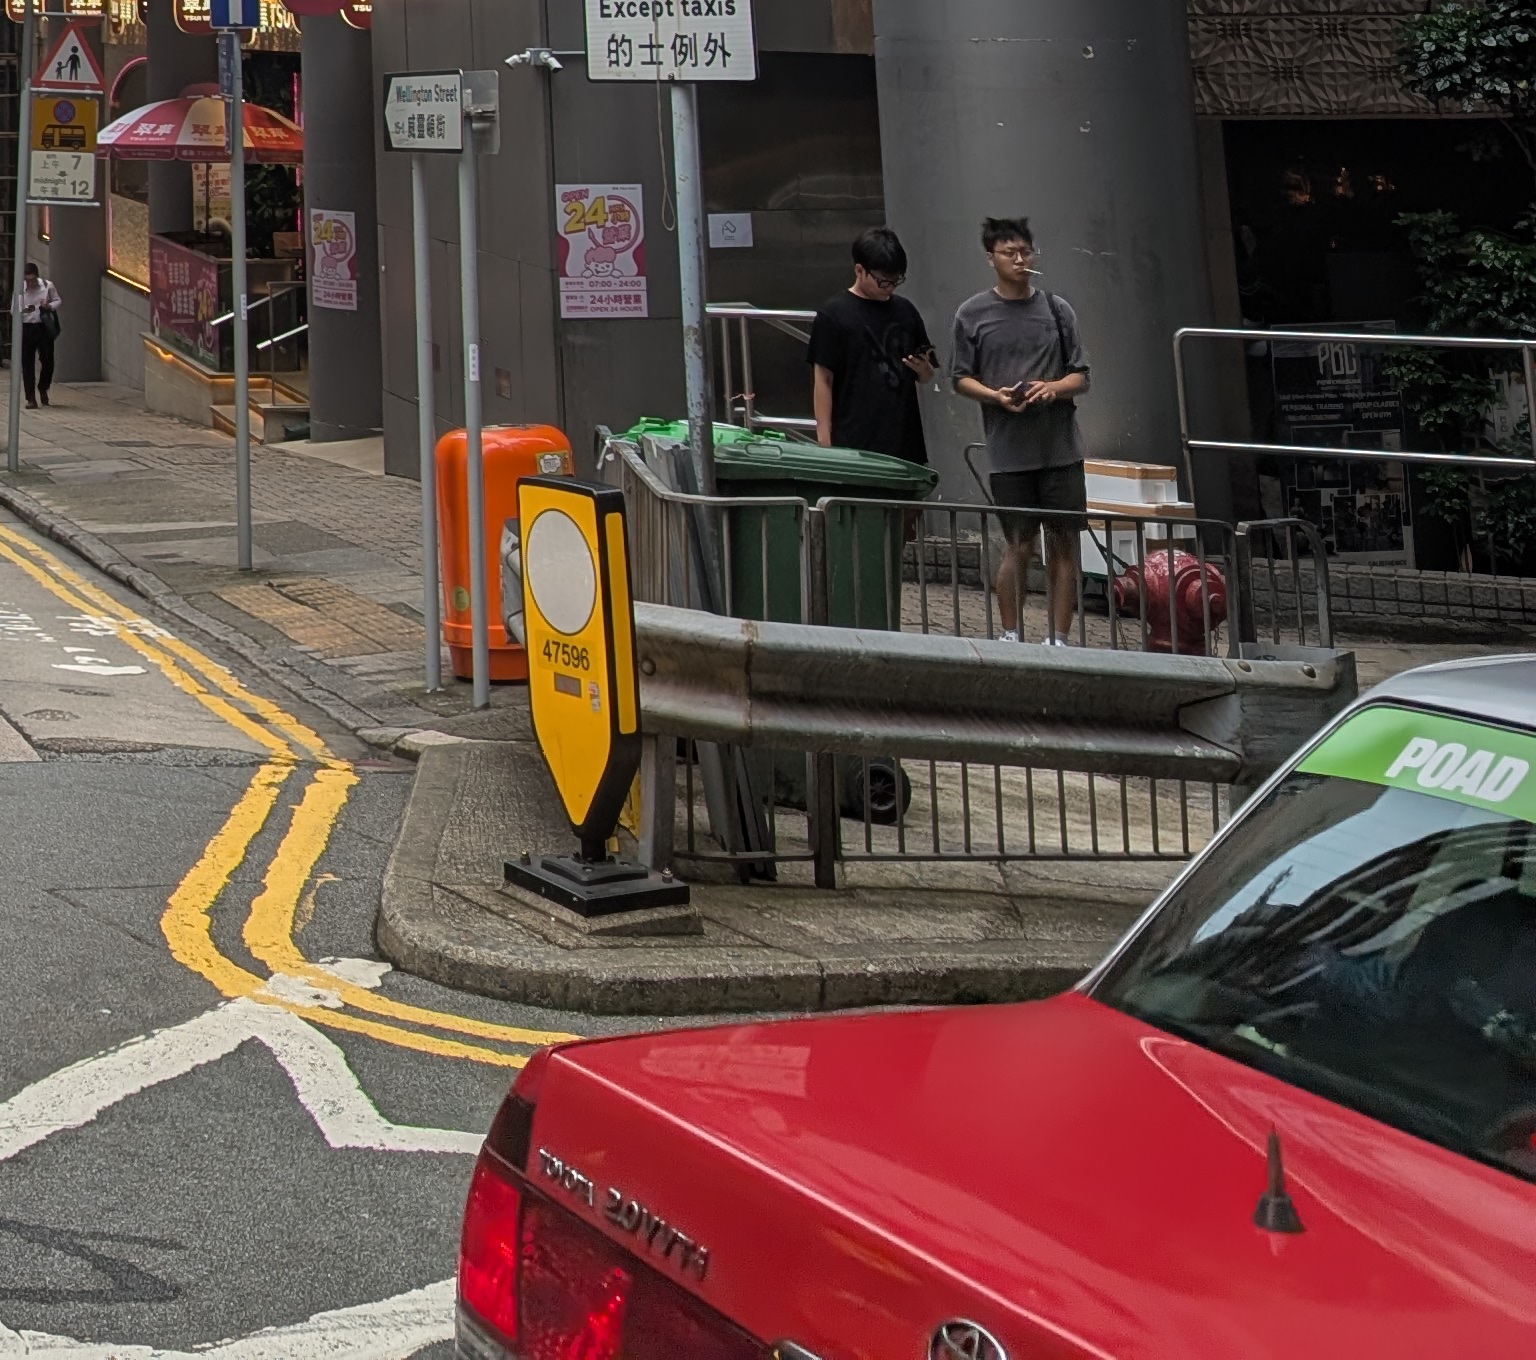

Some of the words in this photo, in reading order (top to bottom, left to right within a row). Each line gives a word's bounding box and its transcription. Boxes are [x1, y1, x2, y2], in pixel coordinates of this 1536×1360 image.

[606, 31, 732, 69] 的士例外
[396, 84, 433, 107] Wellington
[434, 83, 458, 102] Street
[70, 154, 82, 170] 7
[70, 179, 90, 196] 12
[563, 195, 609, 235] 24
[588, 280, 612, 289] 07:00
[618, 280, 642, 288] 24:00
[543, 639, 590, 671] 47596
[1384, 736, 1530, 803] POAD
